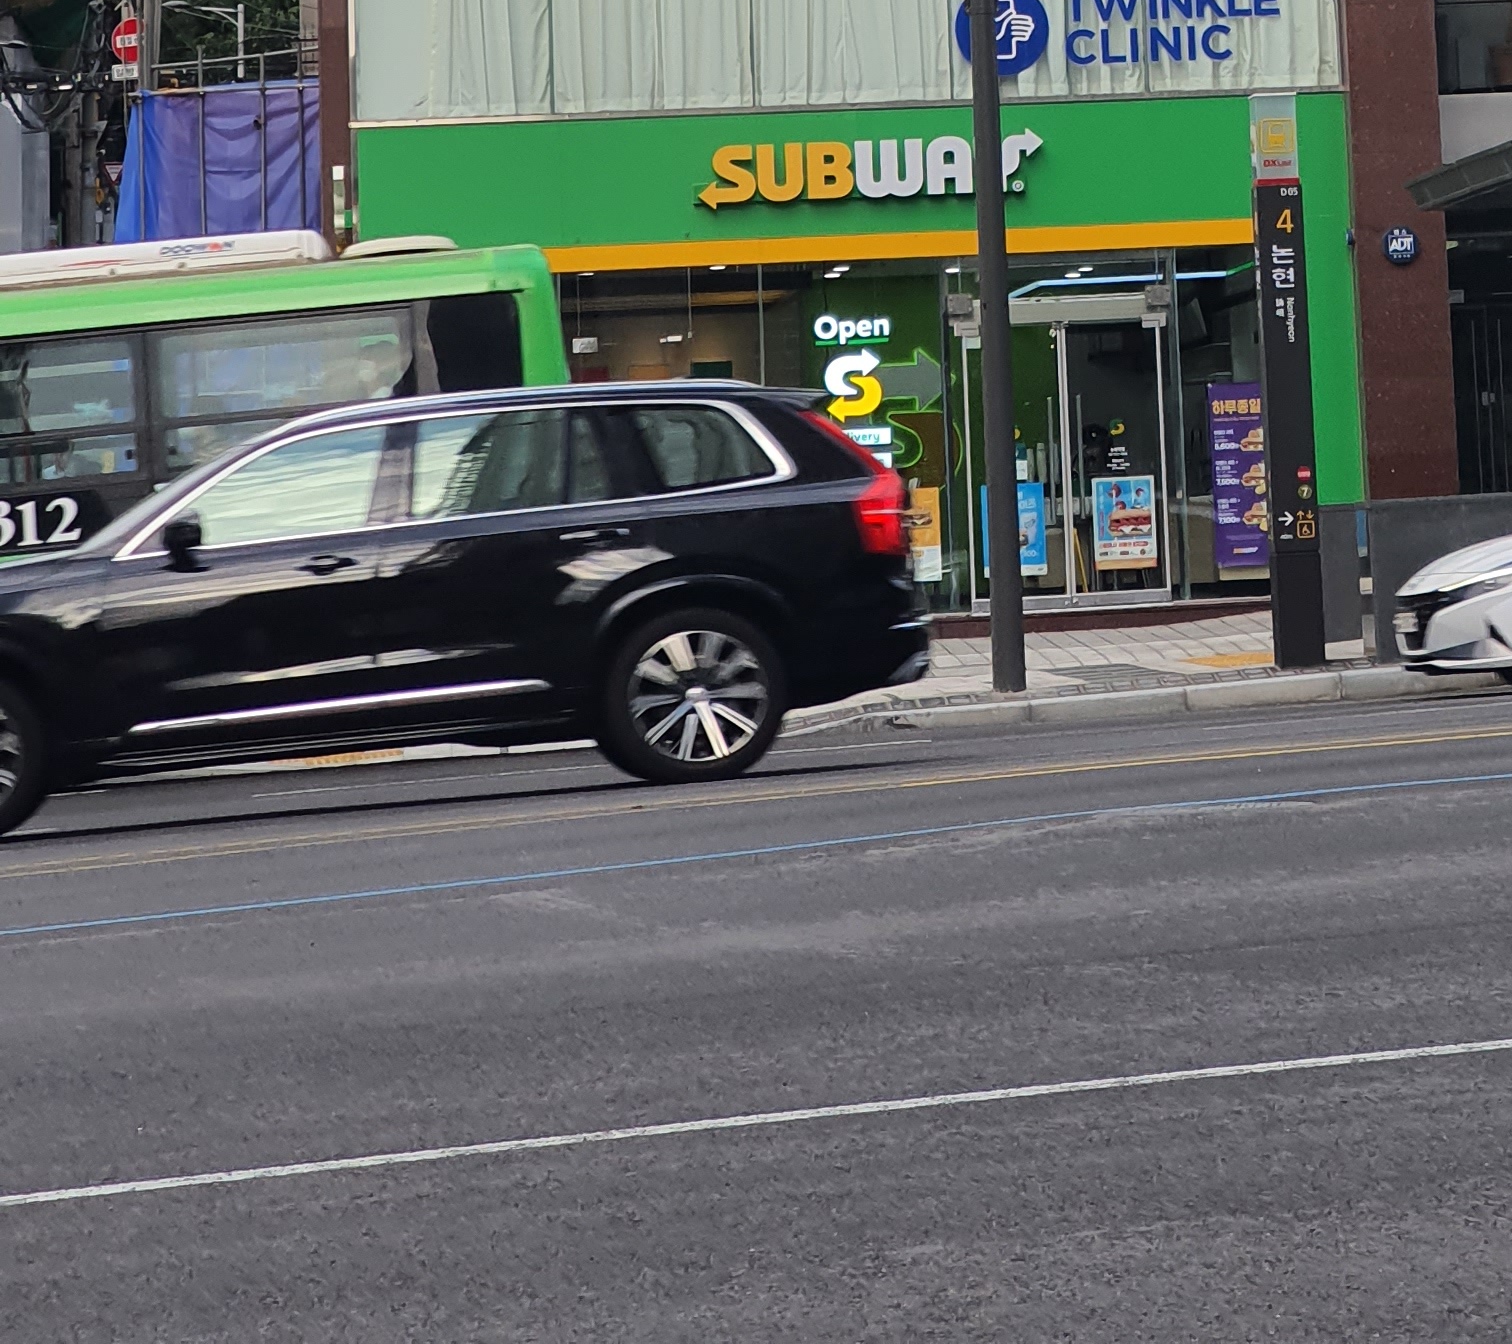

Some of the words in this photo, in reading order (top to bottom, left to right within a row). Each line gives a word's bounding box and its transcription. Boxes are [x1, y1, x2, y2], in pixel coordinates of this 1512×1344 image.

[1066, 24, 1233, 66] CLINIC
[697, 127, 1044, 210] SUBWAY
[1275, 208, 1295, 234] 4
[1390, 237, 1413, 252] ADT
[1271, 244, 1296, 290] 논현
[813, 314, 891, 344] Open
[847, 429, 881, 444] livery
